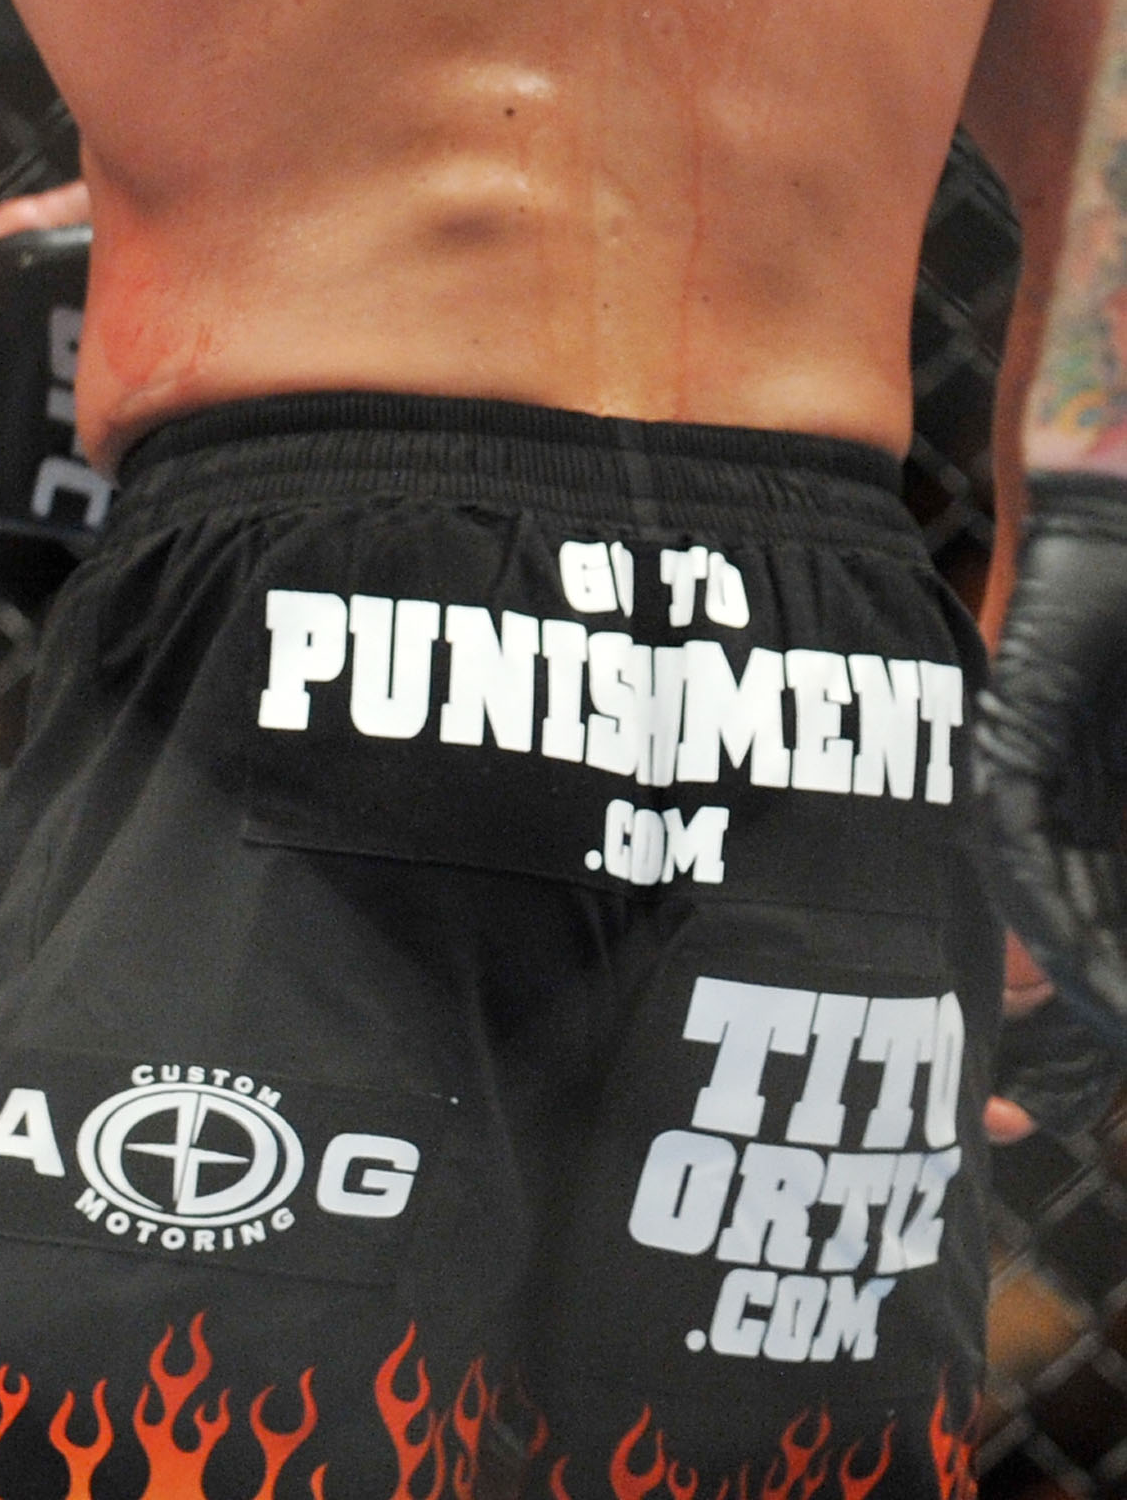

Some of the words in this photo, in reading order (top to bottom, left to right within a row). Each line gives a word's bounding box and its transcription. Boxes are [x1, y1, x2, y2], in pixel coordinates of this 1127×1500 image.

[660, 546, 750, 628] TO
[258, 589, 964, 804] PUNISHMENT
[584, 799, 730, 885] .COM
[131, 1064, 283, 1108] CUSTOM
[683, 976, 965, 1149] TITO
[74, 1187, 296, 1252] MOTORING
[628, 1129, 962, 1275] ORTIZ
[685, 1268, 898, 1362] .COM
